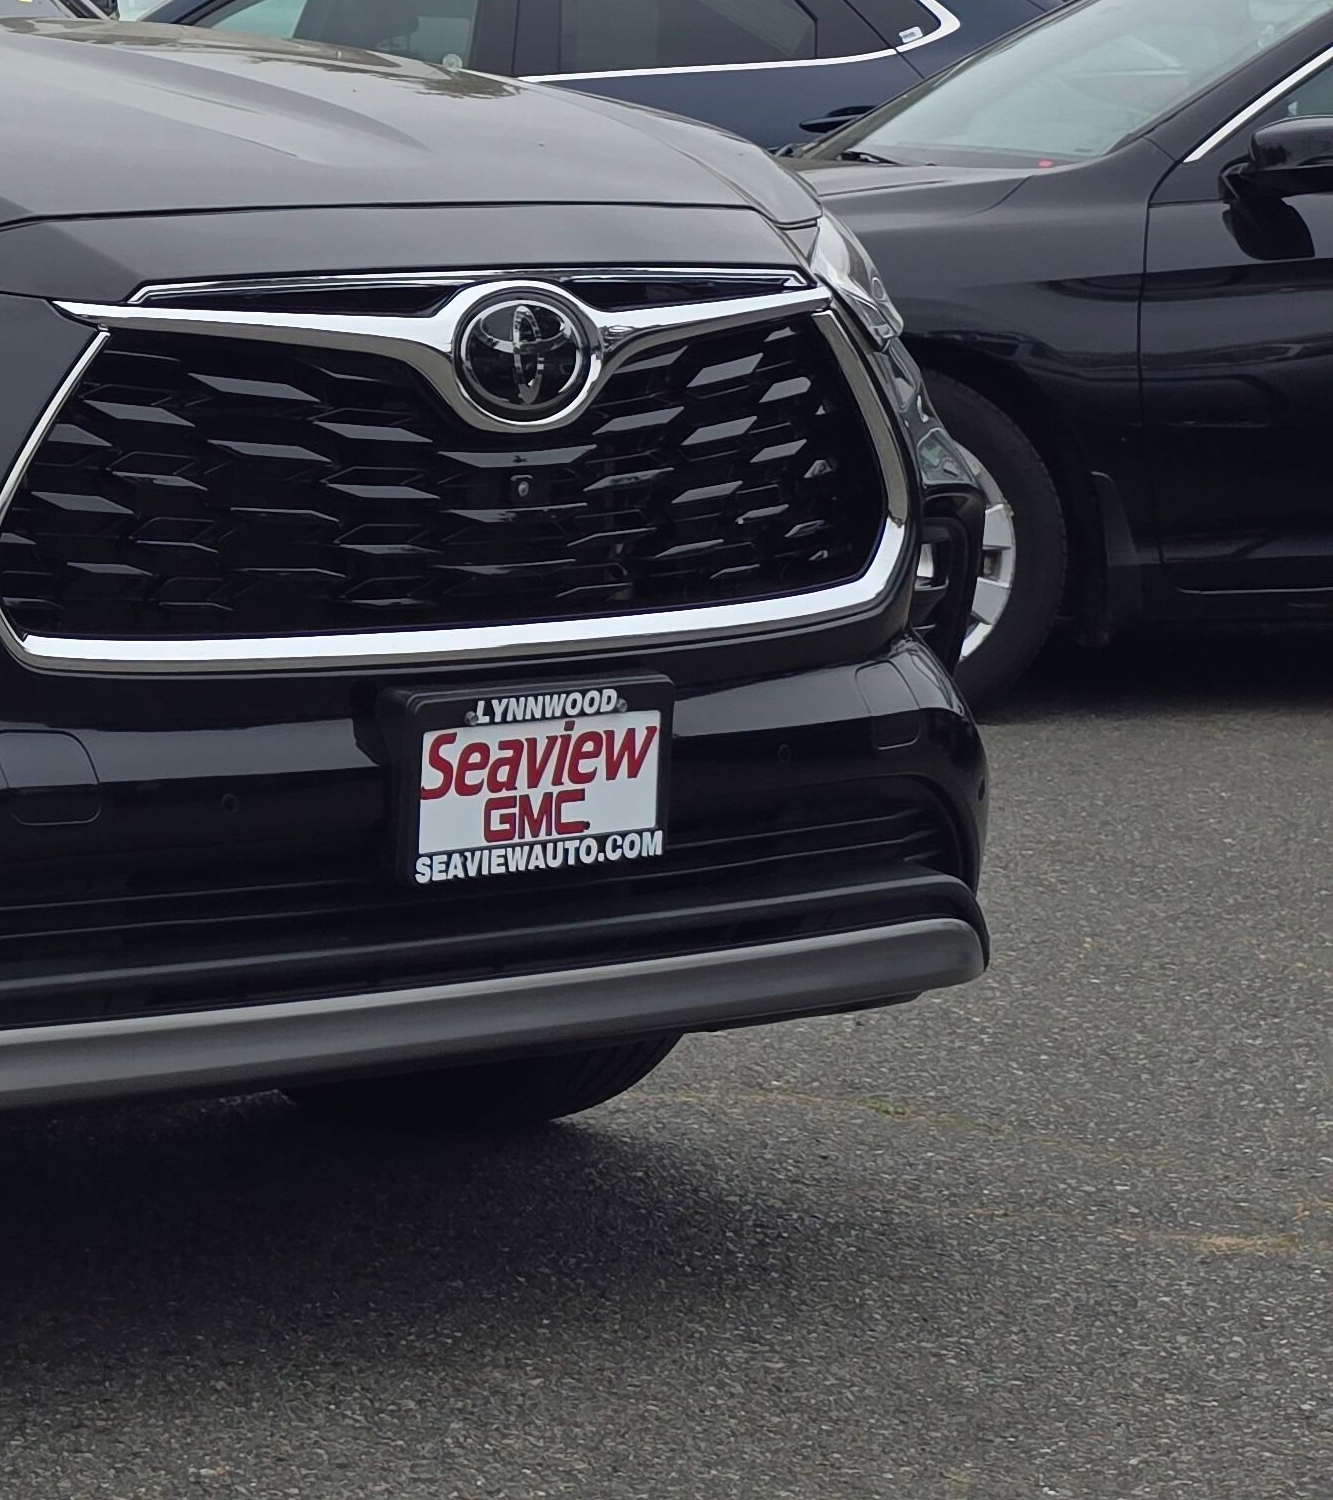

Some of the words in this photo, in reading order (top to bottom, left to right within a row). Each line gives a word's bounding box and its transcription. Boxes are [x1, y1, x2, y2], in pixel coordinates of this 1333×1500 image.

[475, 688, 618, 724] LYNNWOOD
[420, 720, 658, 800] Seaview
[483, 788, 587, 843] GMC
[414, 830, 664, 885] SEAVIEWAUTO.COM
